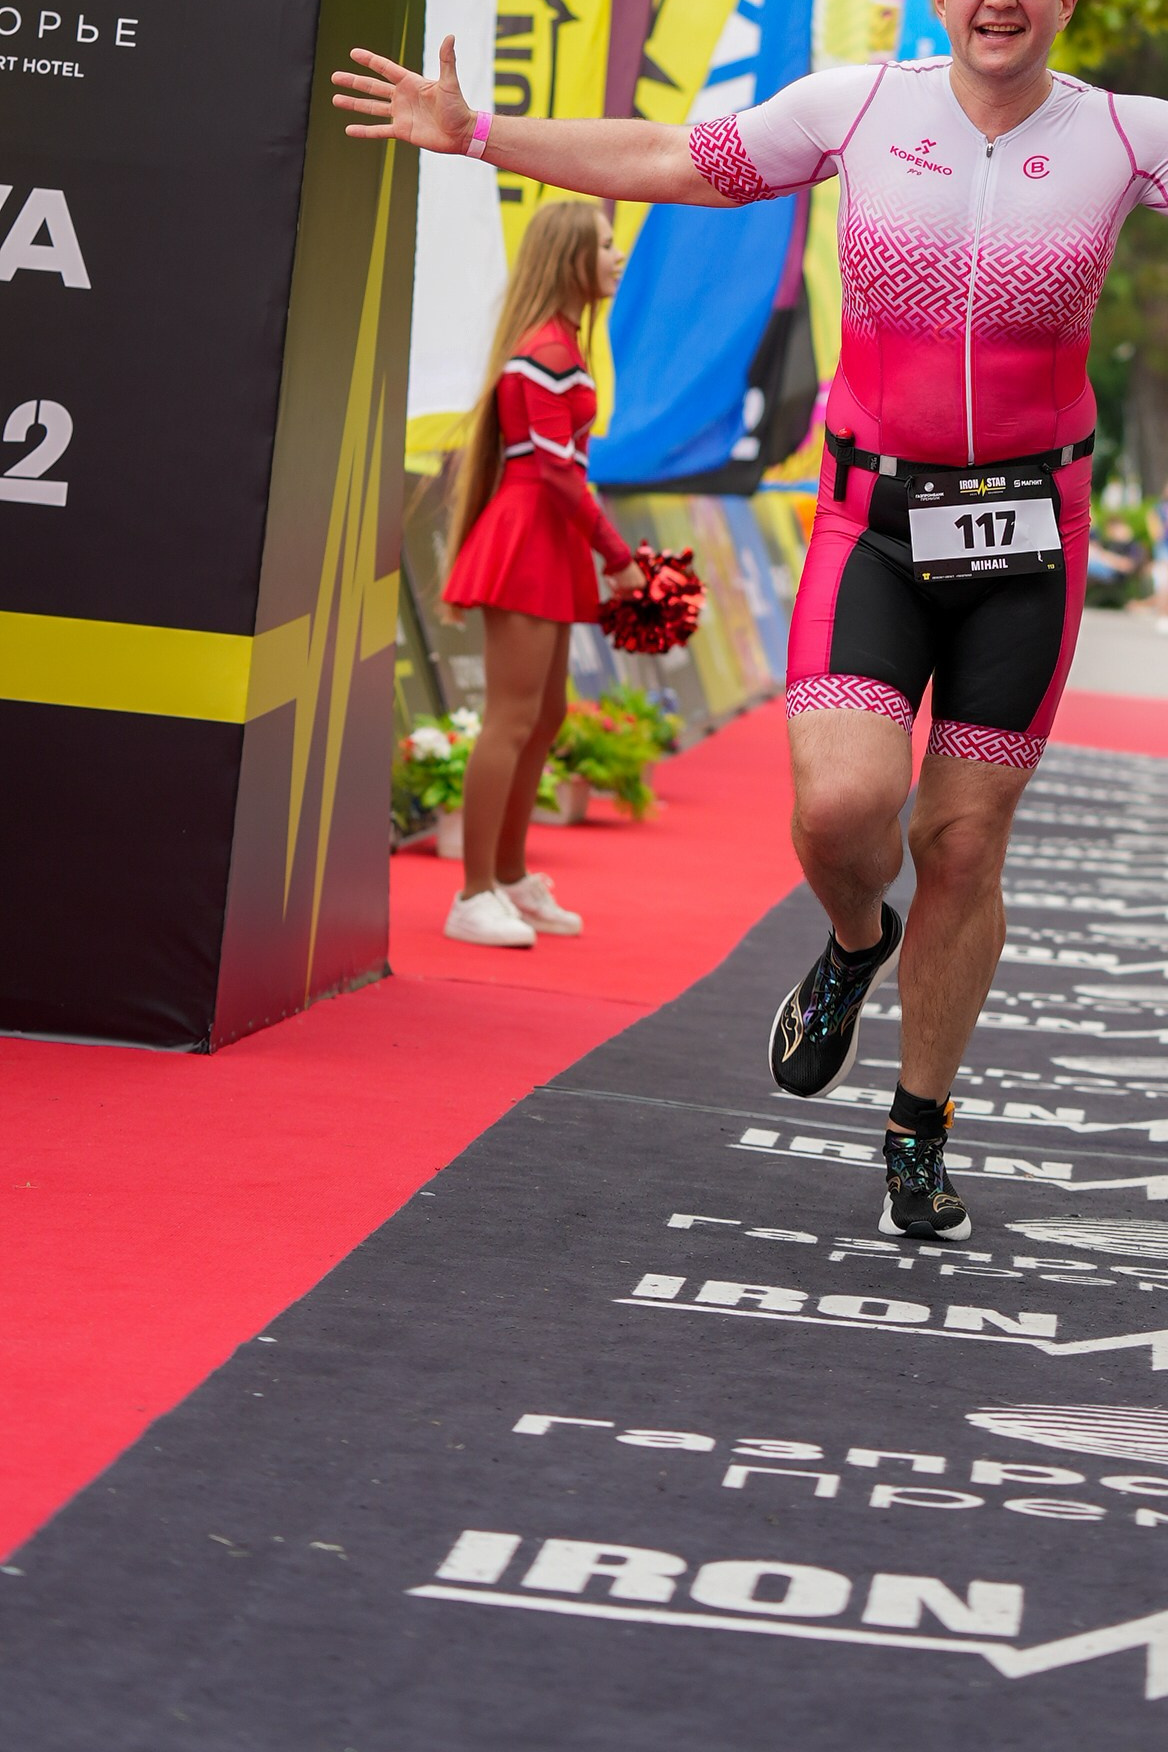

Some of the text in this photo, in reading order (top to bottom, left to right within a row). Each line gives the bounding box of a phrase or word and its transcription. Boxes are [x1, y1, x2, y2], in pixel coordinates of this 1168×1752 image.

[23, 58, 85, 78] HOTEL
[890, 145, 953, 176] KOPENKO
[0, 184, 92, 290] A
[959, 476, 1007, 490] IRON STAR
[954, 510, 1016, 549] 117
[970, 558, 1009, 571] MIHAIL
[632, 1274, 1059, 1338] IRON
[436, 1530, 1024, 1637] IRON
